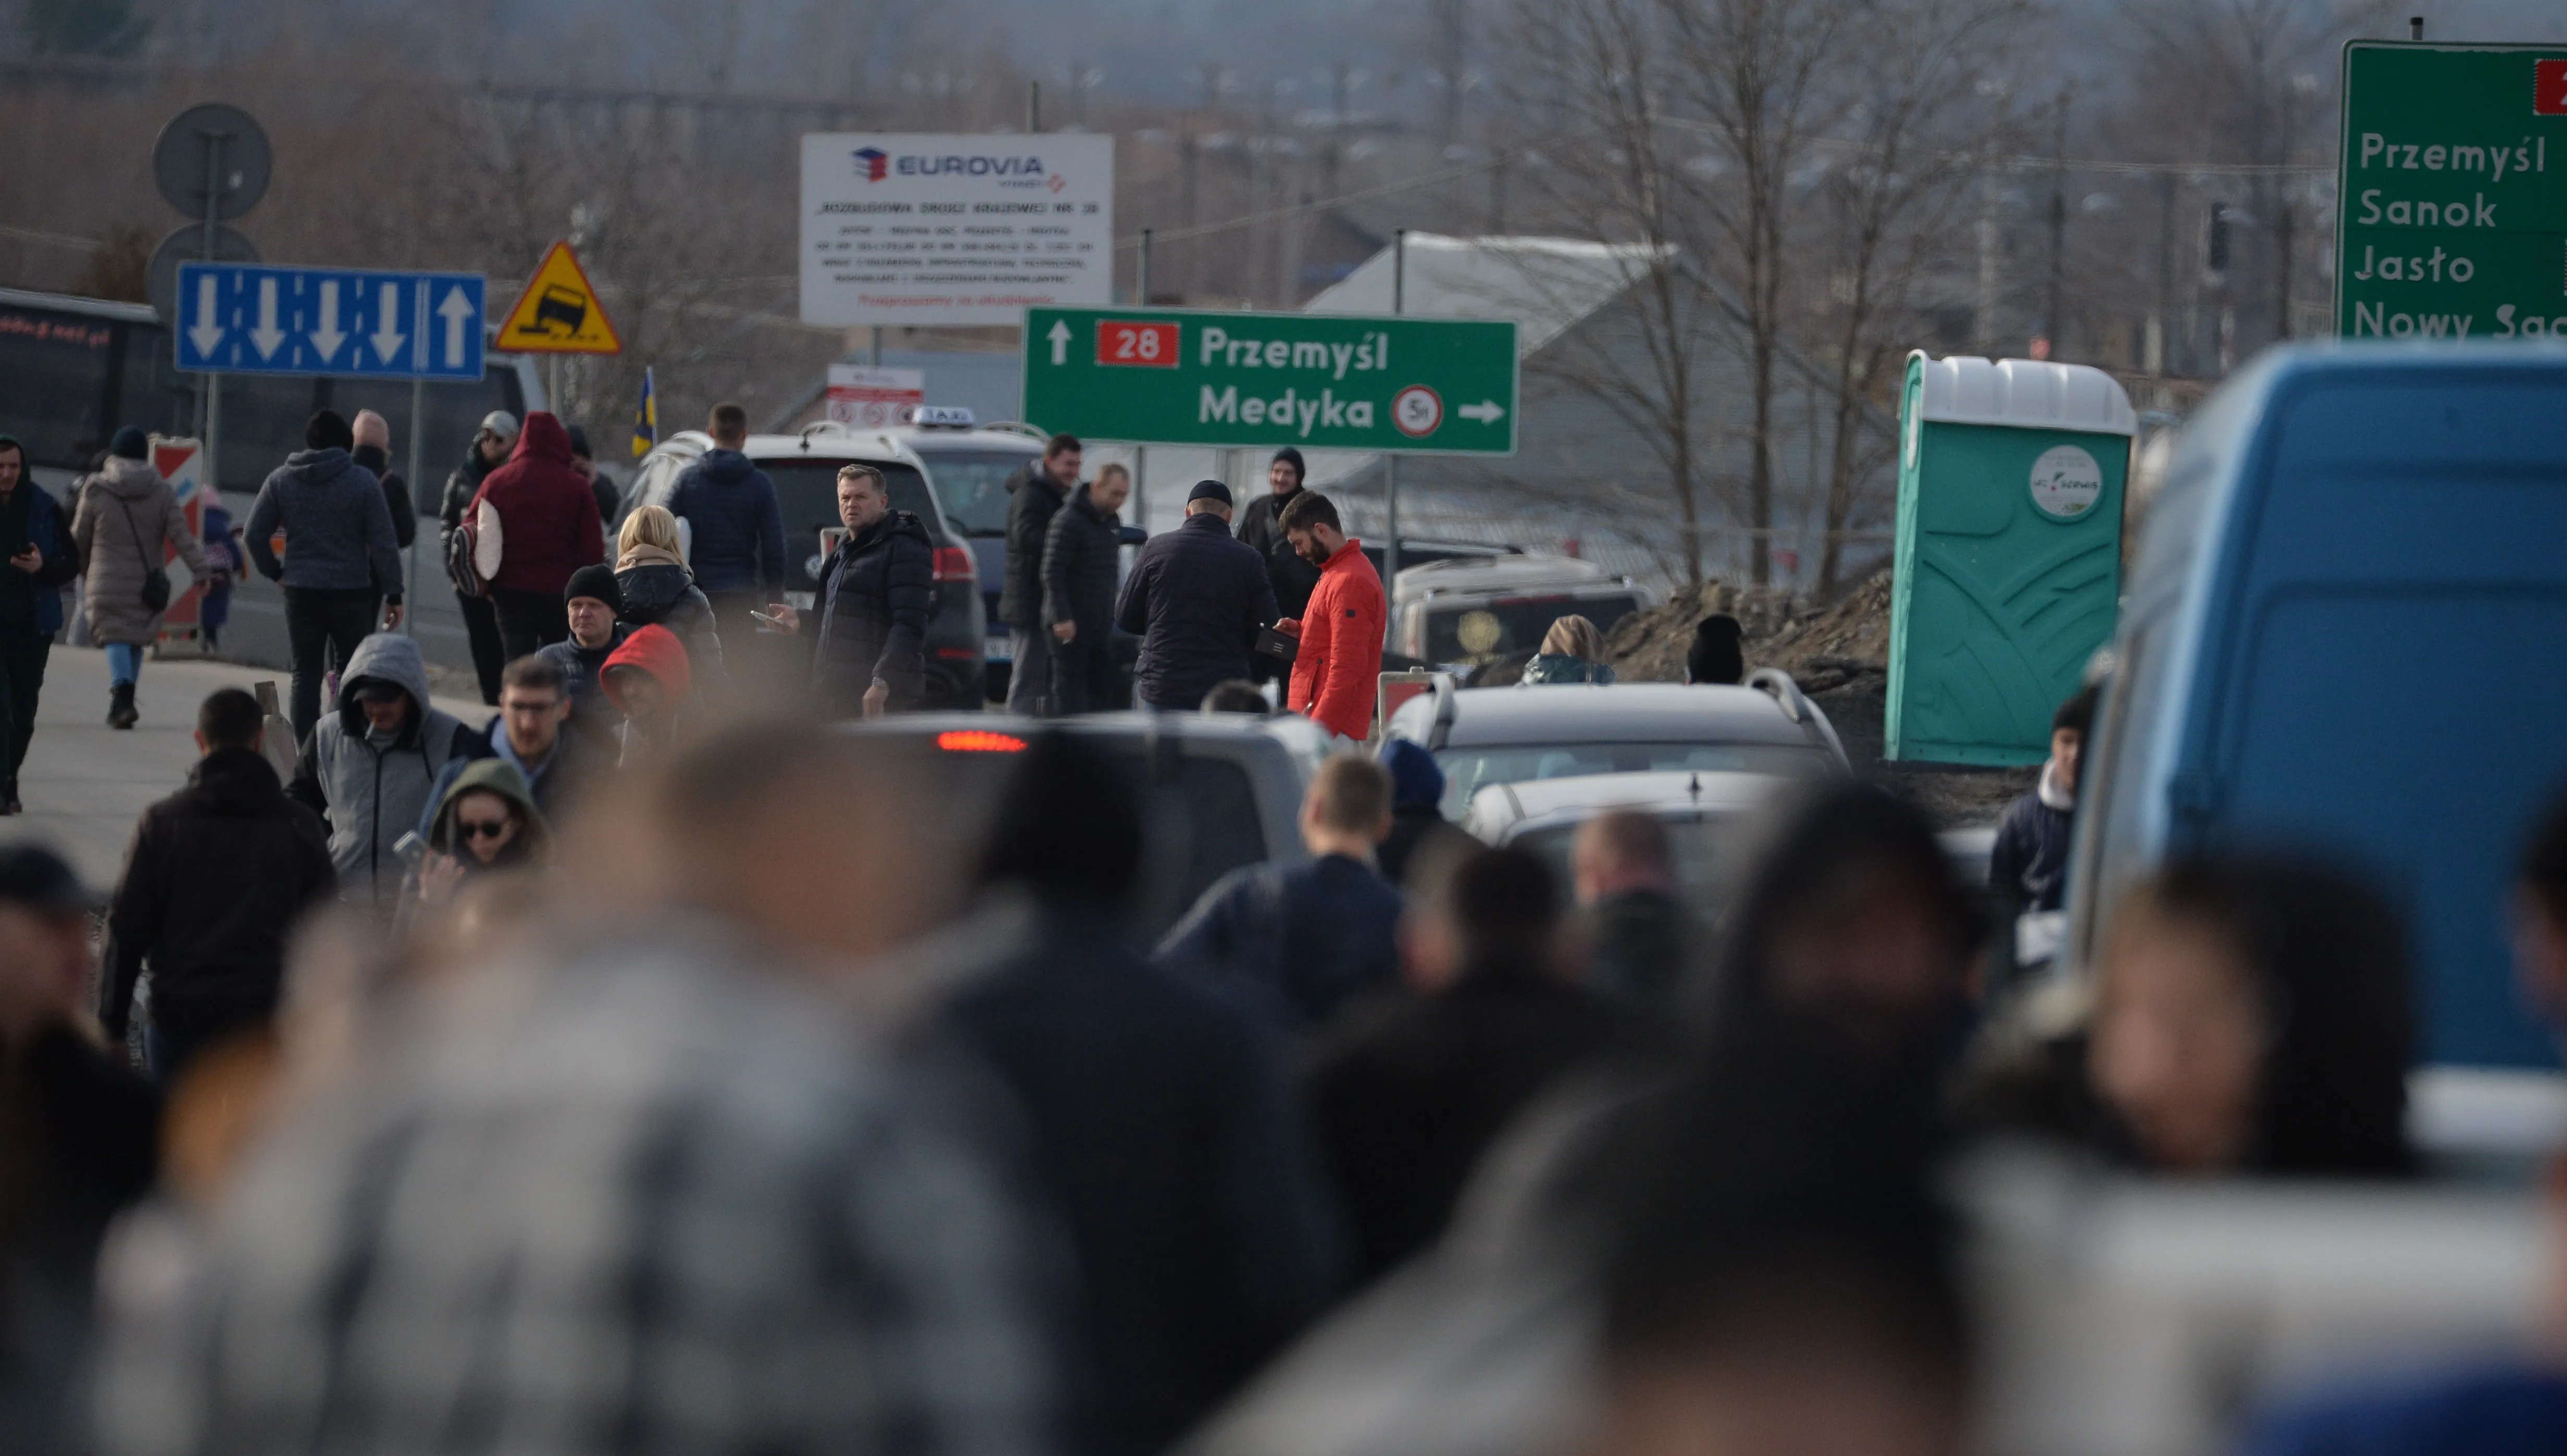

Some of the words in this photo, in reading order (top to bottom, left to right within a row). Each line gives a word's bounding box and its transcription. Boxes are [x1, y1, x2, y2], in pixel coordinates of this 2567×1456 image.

[896, 156, 1044, 176] EUROVIA
[2361, 132, 2545, 182] Przemyśl
[2358, 189, 2497, 228] Sanok
[2354, 245, 2474, 283] Jasło
[2354, 300, 2474, 344] Nowy
[1116, 328, 1160, 359] 28
[1200, 326, 1388, 380] Przemyśl
[1199, 384, 1374, 438] Medyka
